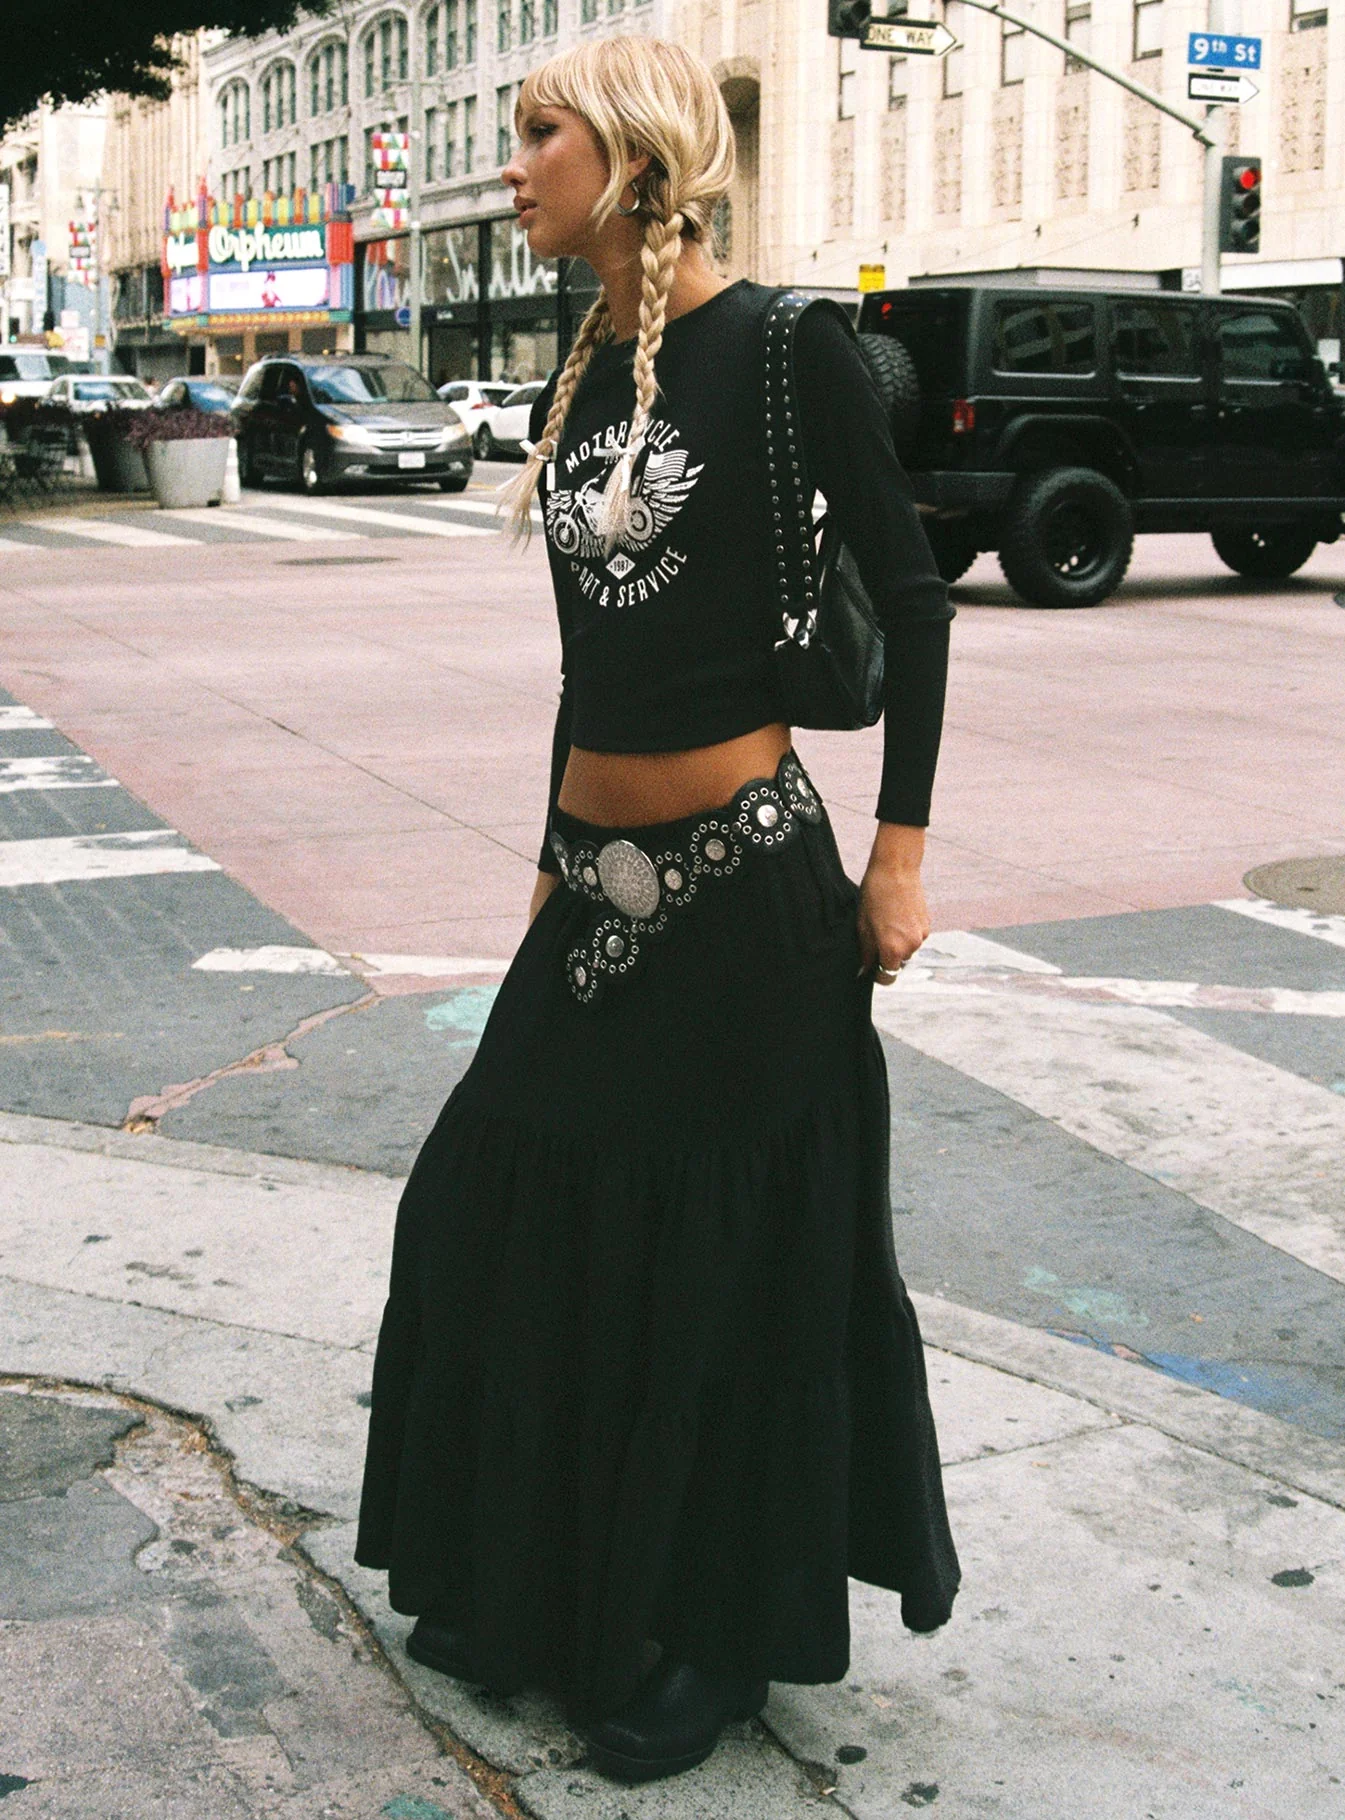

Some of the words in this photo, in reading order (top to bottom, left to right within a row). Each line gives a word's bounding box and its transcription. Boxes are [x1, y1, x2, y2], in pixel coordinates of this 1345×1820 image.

[869, 26, 895, 43] ONE
[905, 29, 934, 45] WAY
[1194, 37, 1228, 61] 9th
[1234, 43, 1257, 63] St
[208, 221, 324, 272] Orpheum
[565, 419, 680, 474] MOTORYCLE
[570, 561, 601, 600] PART
[599, 586, 610, 607] &
[617, 546, 687, 608] SERVICE
